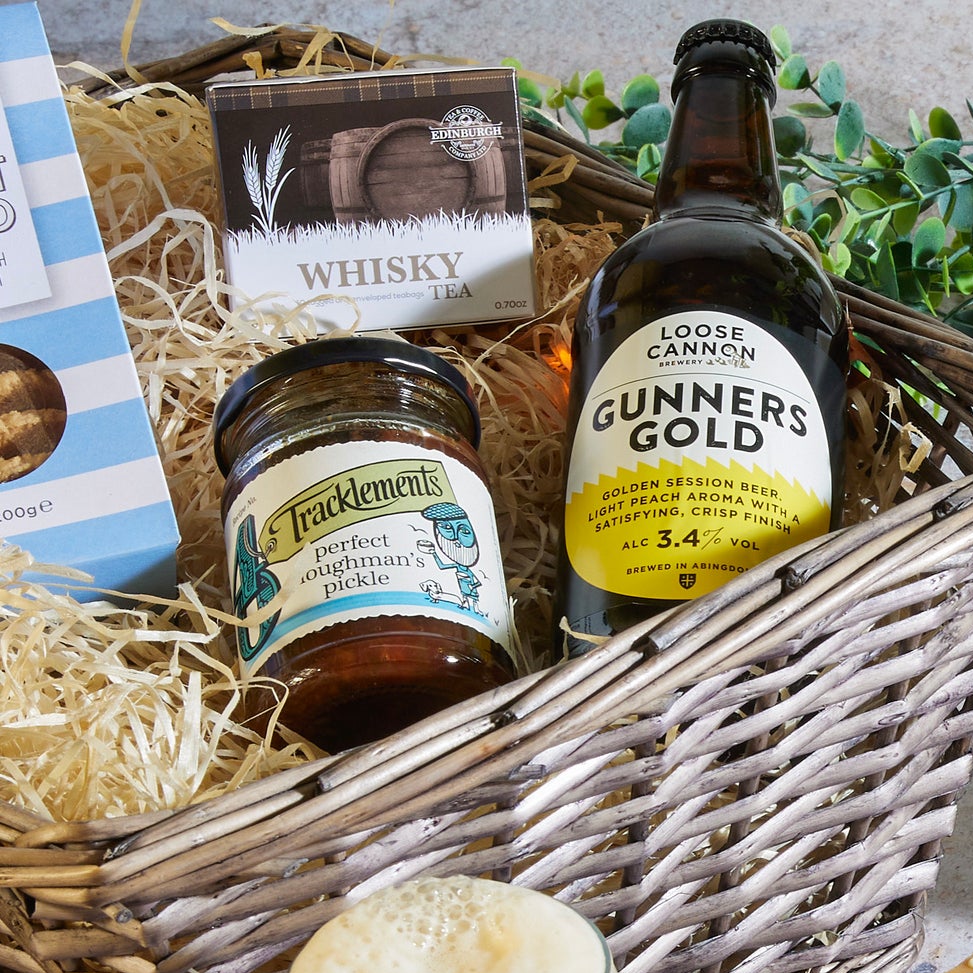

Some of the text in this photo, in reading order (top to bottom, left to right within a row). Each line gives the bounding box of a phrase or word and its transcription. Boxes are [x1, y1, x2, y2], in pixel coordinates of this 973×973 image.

[445, 111, 456, 121] TEA
[461, 108, 485, 120] COFFEE
[431, 126, 502, 139] EDINBURGH
[449, 145, 476, 158] COMPANY
[297, 252, 464, 290] WHISKY
[393, 291, 424, 300] teabags
[428, 282, 473, 300] TEA
[494, 300, 527, 310] 0.70oz
[661, 324, 744, 341] LOOSE
[647, 341, 755, 361] CANNON
[659, 359, 703, 368] BREWERY
[592, 382, 808, 437] GUNNERS
[629, 417, 764, 453] GOLD
[602, 477, 782, 501] GOLDEN SESSION BEER.
[268, 465, 443, 543] Tracklements
[588, 492, 800, 525] LIGHT PEACH AROMA WITH A
[595, 507, 791, 535] SATISFYING, CRISP FINISH
[315, 533, 389, 562] perfect
[622, 527, 760, 551] ALC 3.4% VOL
[626, 563, 671, 575] BREWED
[676, 562, 687, 570] IN
[323, 571, 390, 599] pickle
